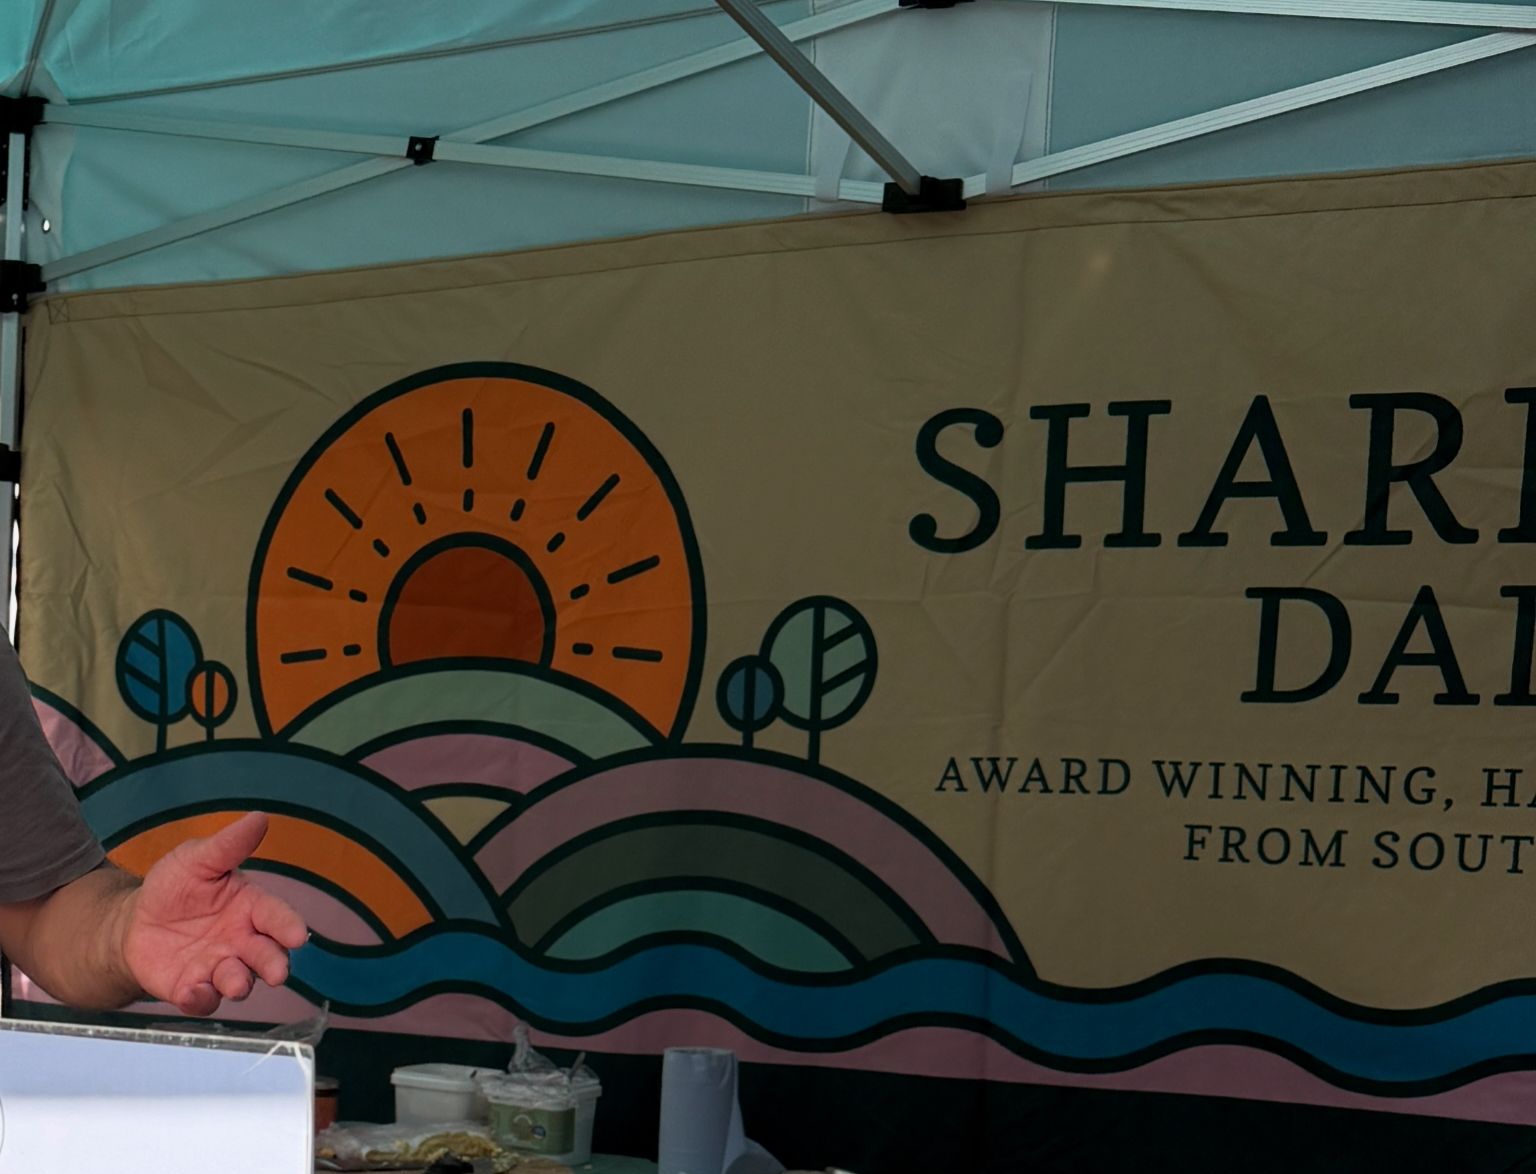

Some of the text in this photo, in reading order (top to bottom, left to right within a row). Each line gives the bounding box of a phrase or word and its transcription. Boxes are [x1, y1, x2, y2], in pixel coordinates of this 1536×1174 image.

[935, 757, 1455, 813] AWARD WINNING,
[1183, 824, 1349, 868] FROM
